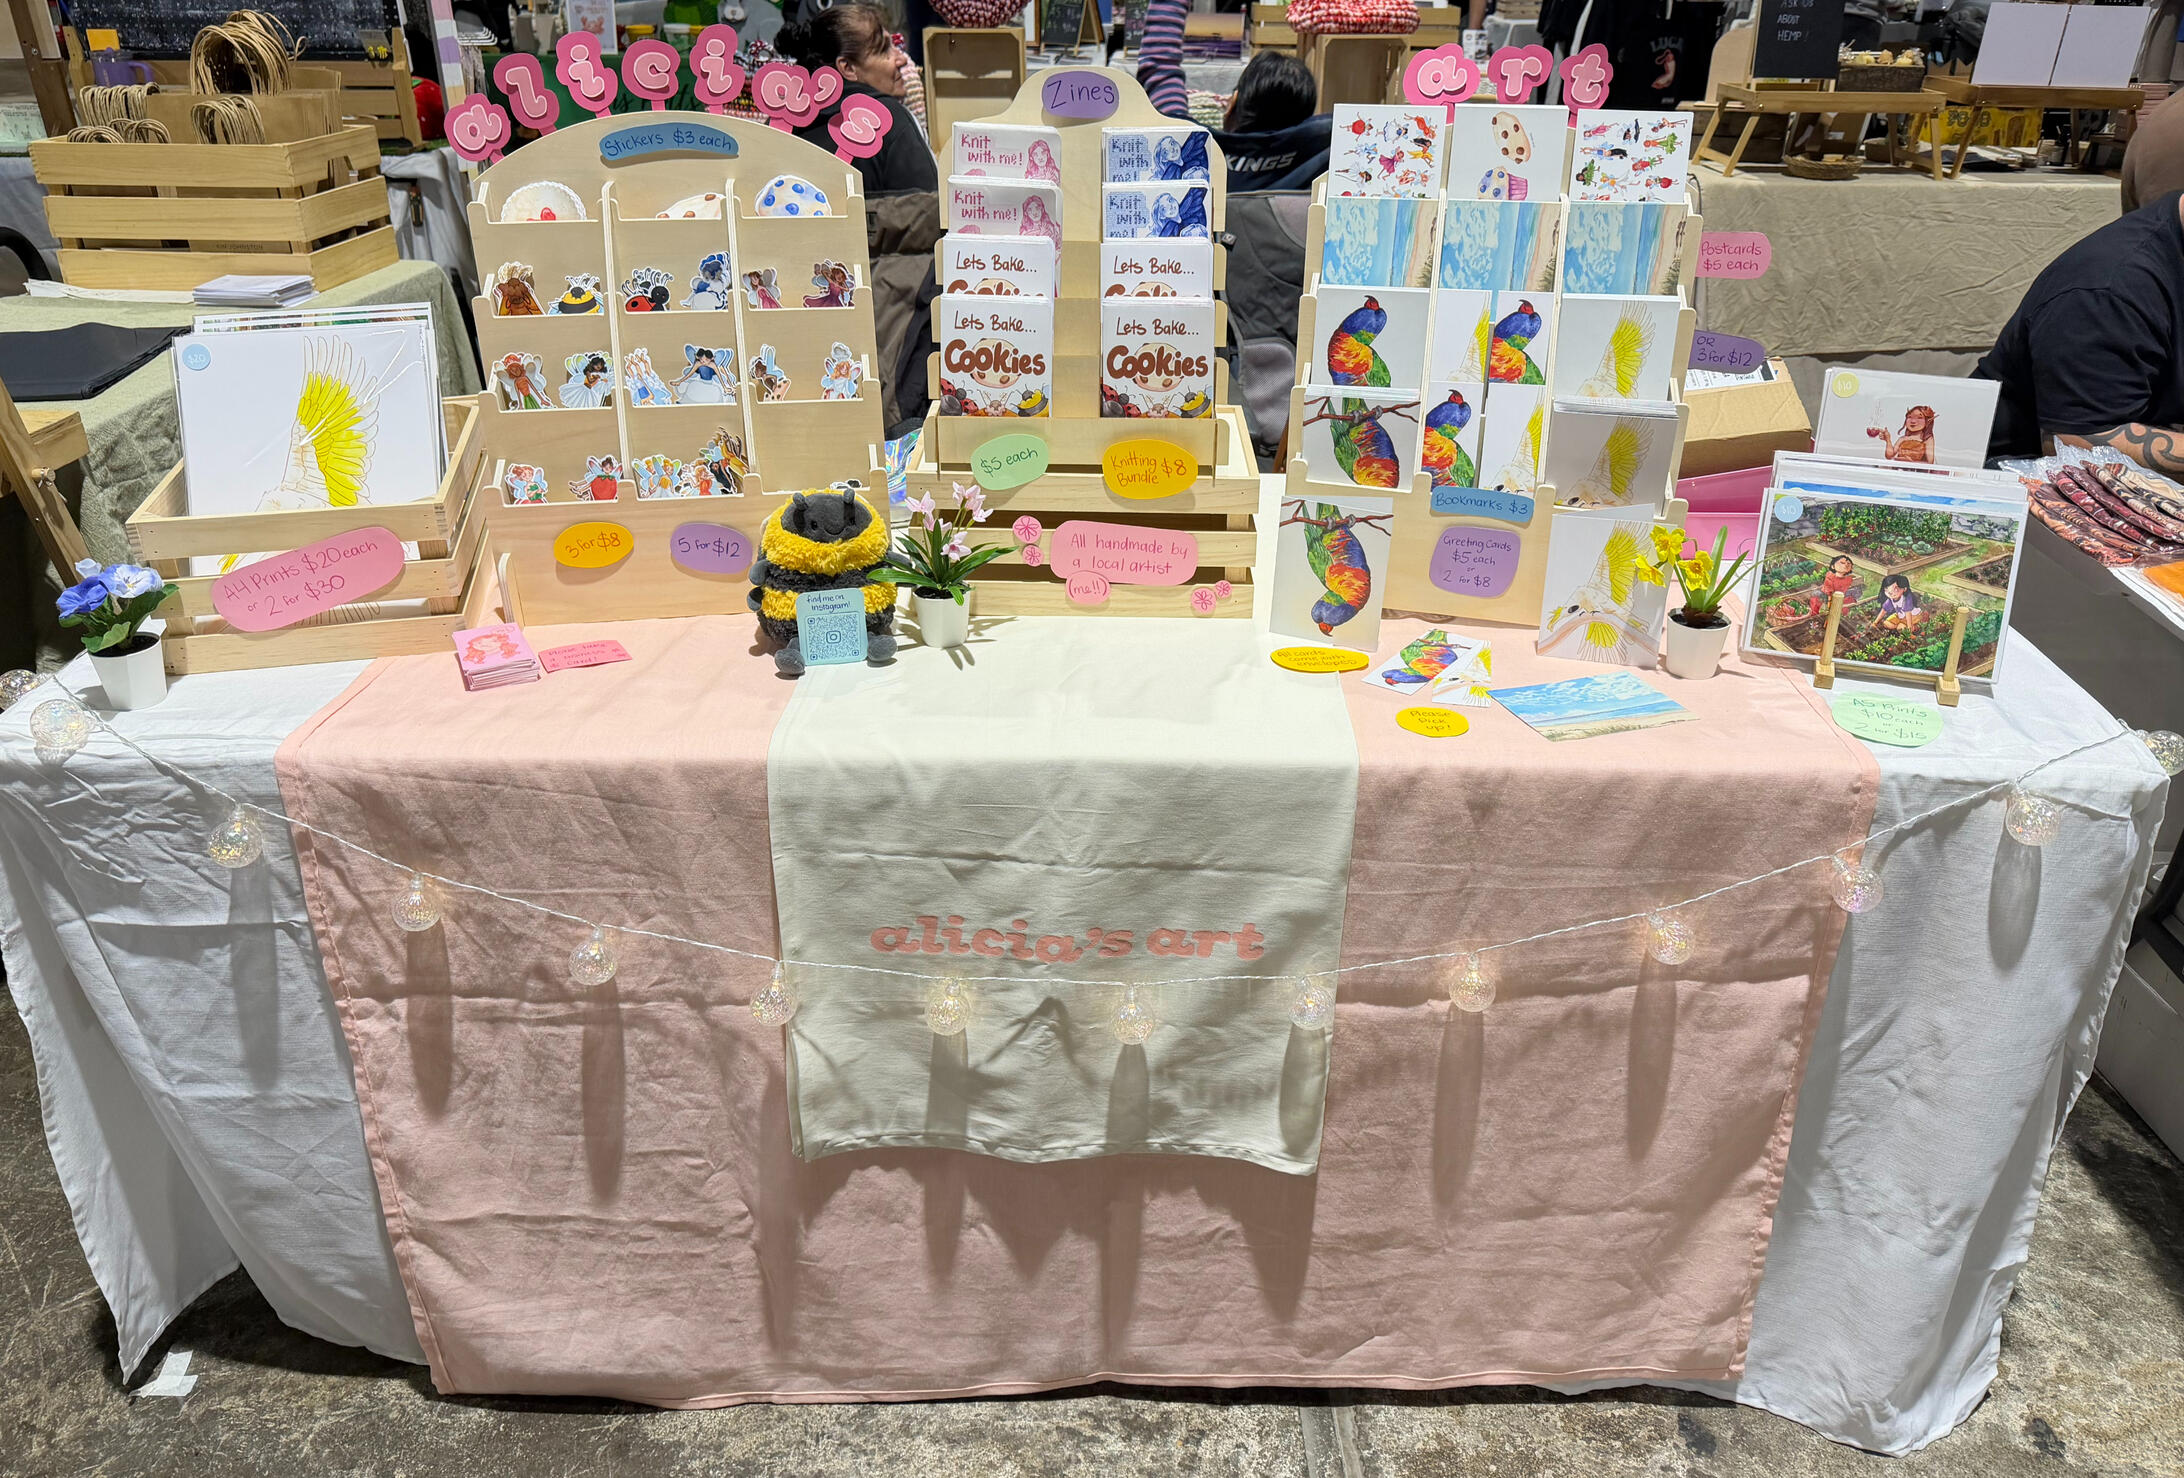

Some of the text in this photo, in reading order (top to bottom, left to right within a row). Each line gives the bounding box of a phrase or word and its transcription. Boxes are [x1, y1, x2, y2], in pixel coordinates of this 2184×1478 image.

[1776, 14, 1800, 25] ABOUT
[1417, 53, 1606, 103] art
[452, 38, 882, 152] alicia's
[1046, 79, 1115, 110] Zines
[603, 127, 732, 157] Stickers $3 each
[960, 133, 991, 149] Knit
[1111, 138, 1143, 153] Knit
[967, 149, 1022, 166] with me!
[1119, 153, 1149, 168] with
[1224, 151, 1298, 172] KINGS
[954, 189, 984, 205] Knit
[1109, 195, 1141, 210] Knit
[961, 205, 1017, 221] with me!
[1116, 210, 1147, 225] with
[1700, 240, 1762, 257] Postcards
[956, 250, 986, 271] Lets
[1113, 255, 1144, 274] Lets
[1703, 258, 1759, 272] $5 each
[954, 310, 985, 331] Lets
[1116, 316, 1148, 336] Lets
[1696, 335, 1716, 347] OR
[944, 338, 1046, 377] Cookies
[1106, 344, 1209, 380] Cookies
[1696, 348, 1752, 367] 3 for $12
[980, 447, 1039, 478] $5 each
[1110, 452, 1187, 478] Knitting $8
[1117, 471, 1160, 488] Bundle
[1435, 492, 1528, 515] Bookmarks $3
[564, 531, 621, 559] 3 for $8
[677, 535, 741, 559] 5 for $12
[1070, 533, 1188, 560] All handmade by
[1442, 535, 1512, 553] Greeting Cards
[1072, 555, 1173, 575] a local artist
[1451, 548, 1496, 566] $5 each
[223, 540, 378, 601] A4 Prints $20 each
[1442, 569, 1452, 583] 2
[1473, 575, 1492, 588] $8
[247, 573, 346, 617] or 2 for $30
[1068, 578, 1108, 599] (me!!)
[1861, 708, 1894, 721] $10
[1893, 727, 1928, 740] $15
[869, 913, 1266, 964] alicia's art
